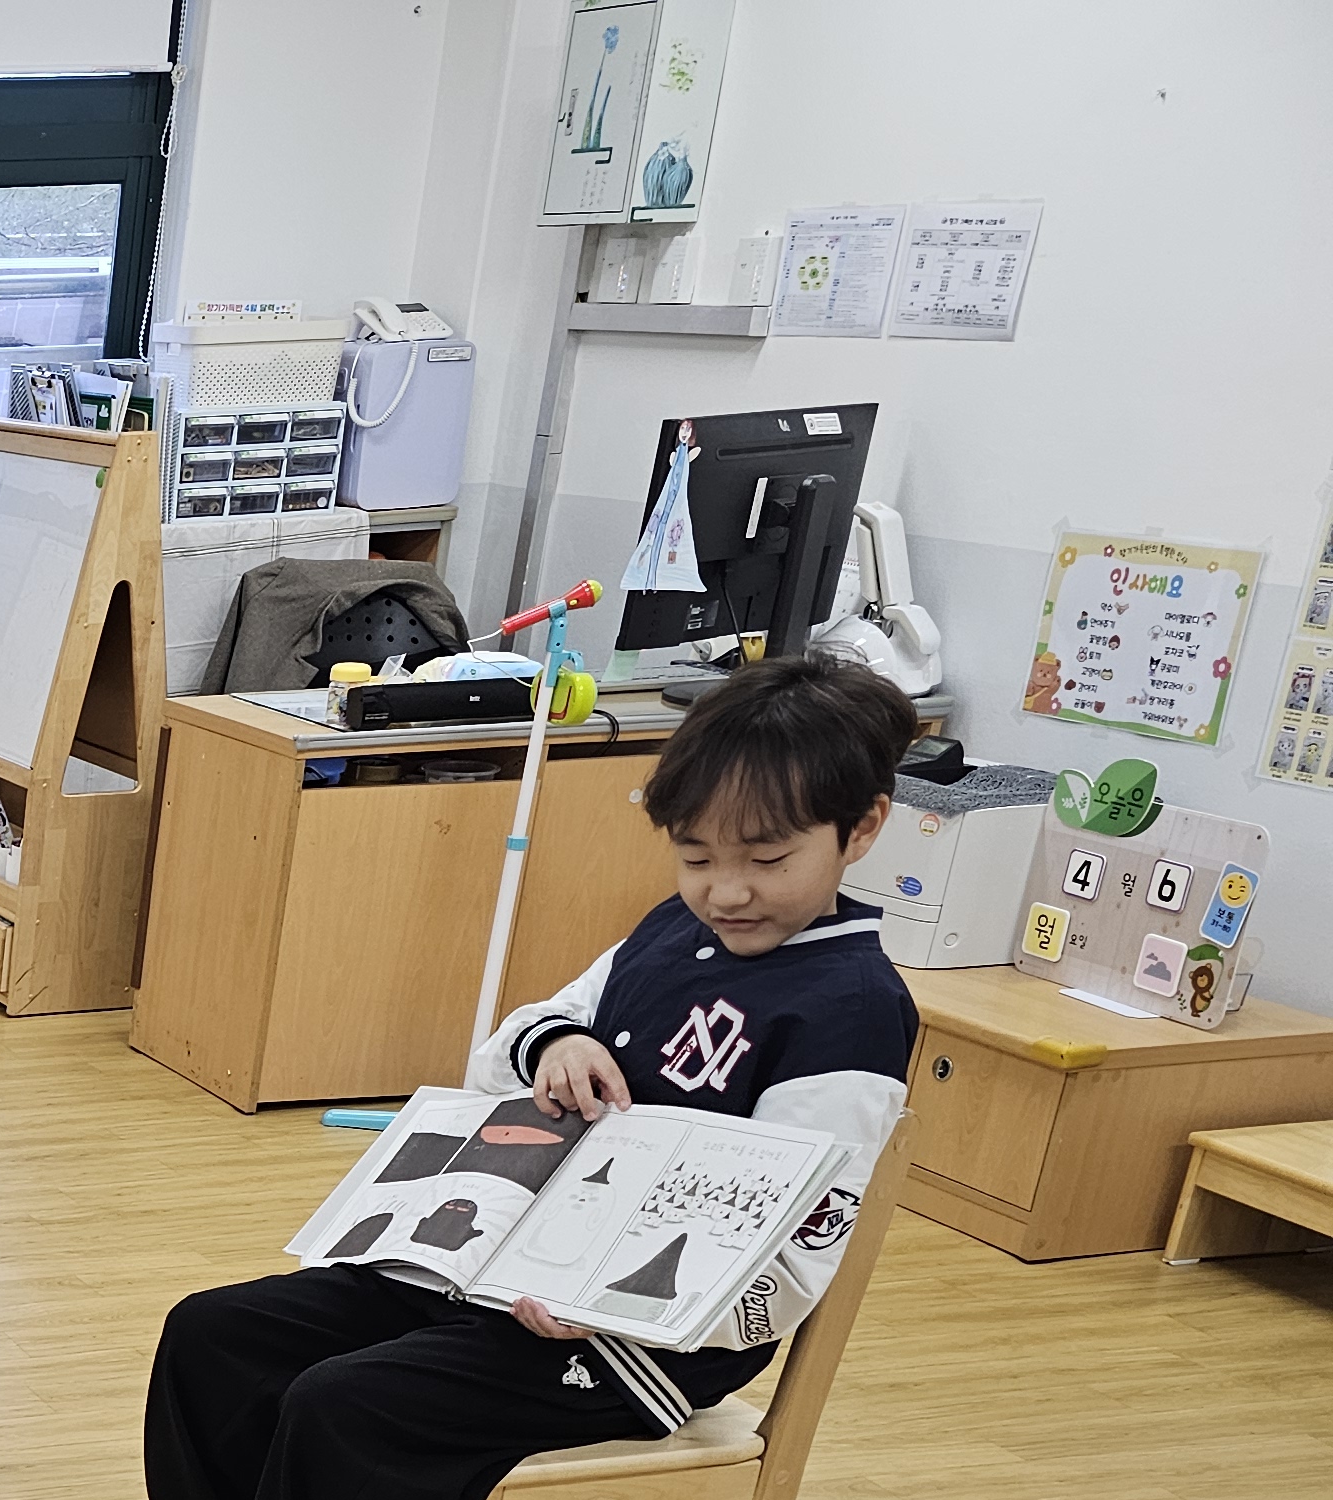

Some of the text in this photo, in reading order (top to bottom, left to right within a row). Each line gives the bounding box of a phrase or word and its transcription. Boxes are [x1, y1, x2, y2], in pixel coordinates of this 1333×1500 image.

[1110, 567, 1183, 599] 인사해요
[1160, 663, 1180, 674] 쿠로미
[1078, 682, 1098, 693] 강아지
[1093, 782, 1144, 820] 오늘은
[1072, 859, 1177, 903] 4 월 6
[1035, 914, 1088, 950] 월 요일
[1216, 908, 1235, 925] 보통
